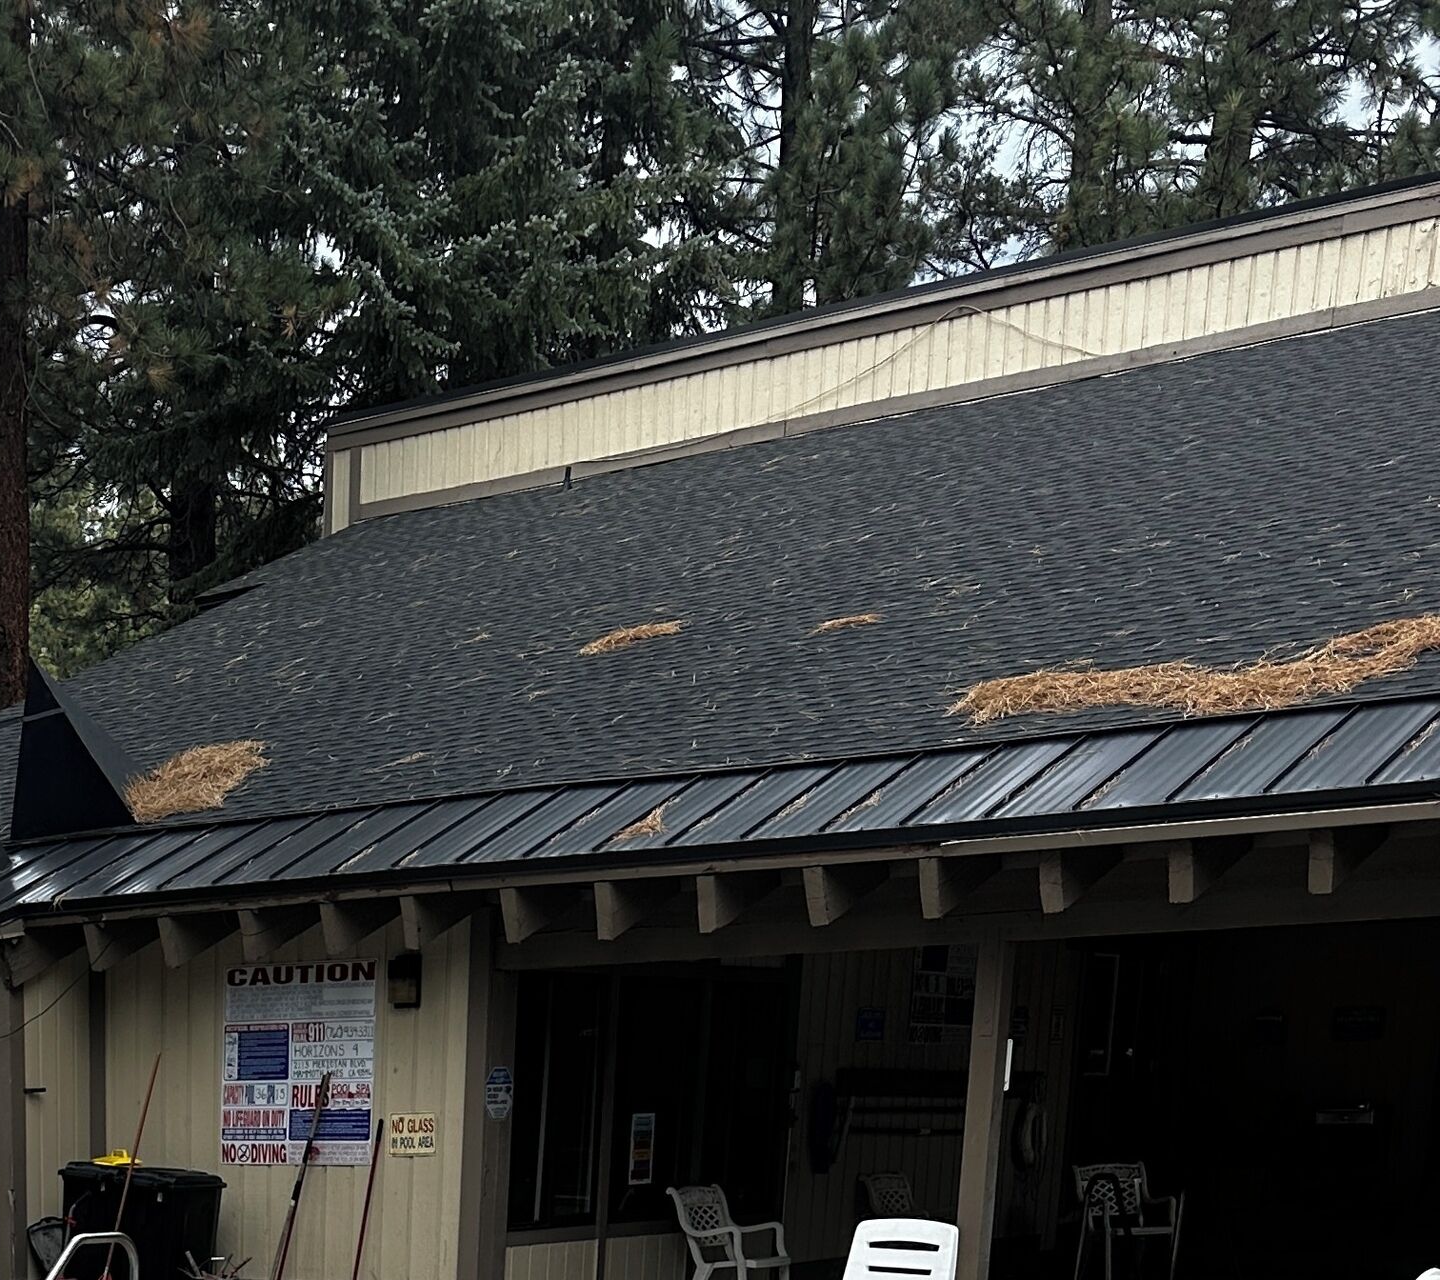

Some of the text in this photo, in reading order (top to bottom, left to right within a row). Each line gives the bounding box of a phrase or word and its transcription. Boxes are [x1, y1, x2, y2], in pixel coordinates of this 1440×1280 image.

[227, 961, 376, 986] CAUTION
[308, 1023, 324, 1042] 911
[293, 1044, 345, 1058] HORIZONS
[255, 1088, 267, 1100] 36
[276, 1088, 286, 1100] 15
[292, 1084, 330, 1107] RULES
[332, 1083, 370, 1093] POOL SPA
[392, 1117, 434, 1134] NO GLASS
[391, 1135, 434, 1149] IN POOL AREA
[222, 1143, 236, 1163] NO
[251, 1143, 287, 1163] DIVING
